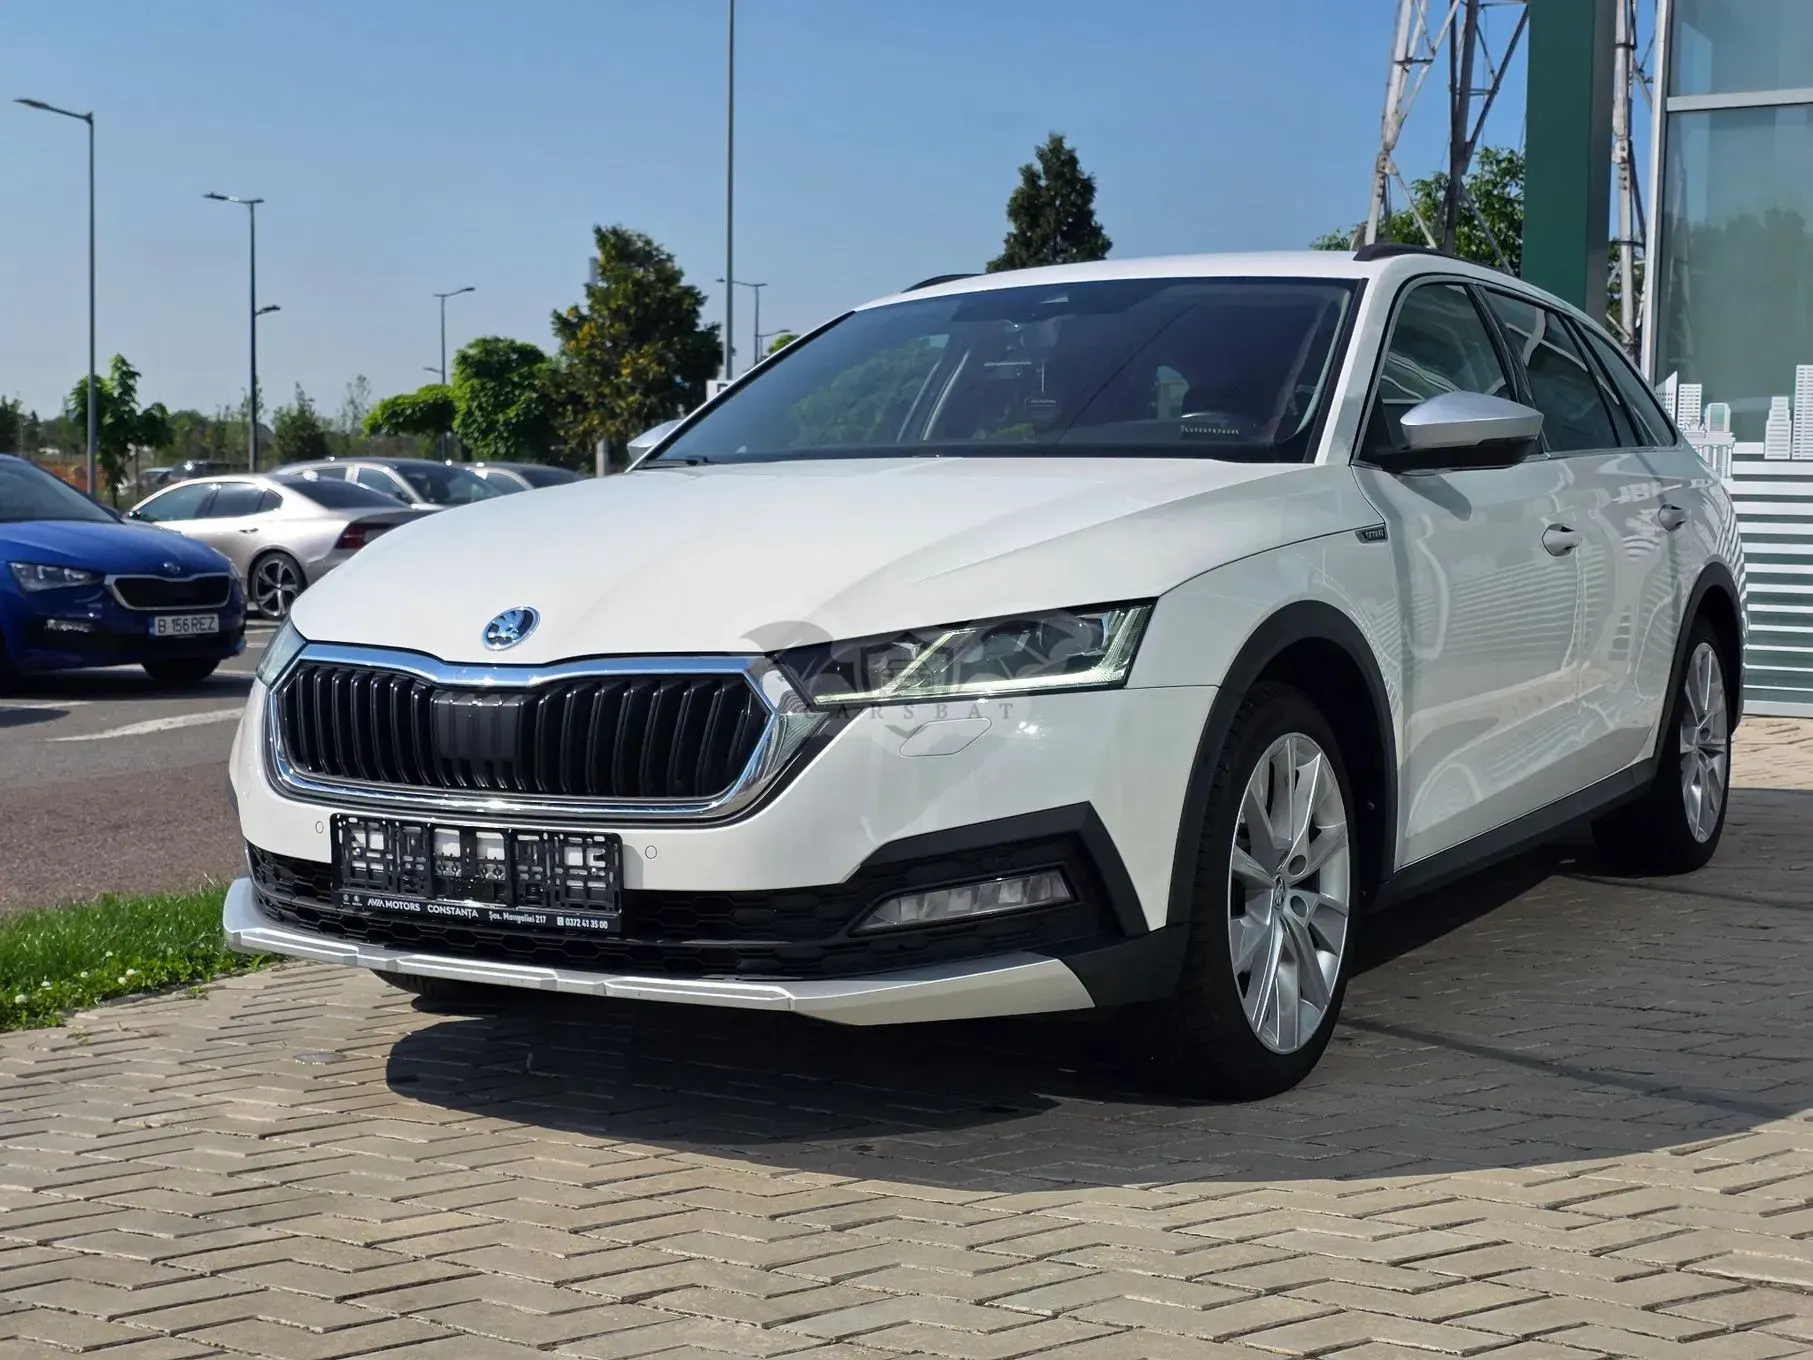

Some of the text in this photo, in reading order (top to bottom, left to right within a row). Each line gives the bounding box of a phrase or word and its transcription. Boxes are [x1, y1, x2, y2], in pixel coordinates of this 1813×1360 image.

[158, 619, 167, 634] B
[385, 900, 421, 912] MOTORS
[535, 915, 547, 924] 217
[565, 917, 581, 927] 0372
[582, 918, 590, 928] 41
[590, 919, 599, 929] 35
[599, 920, 608, 930] 00
